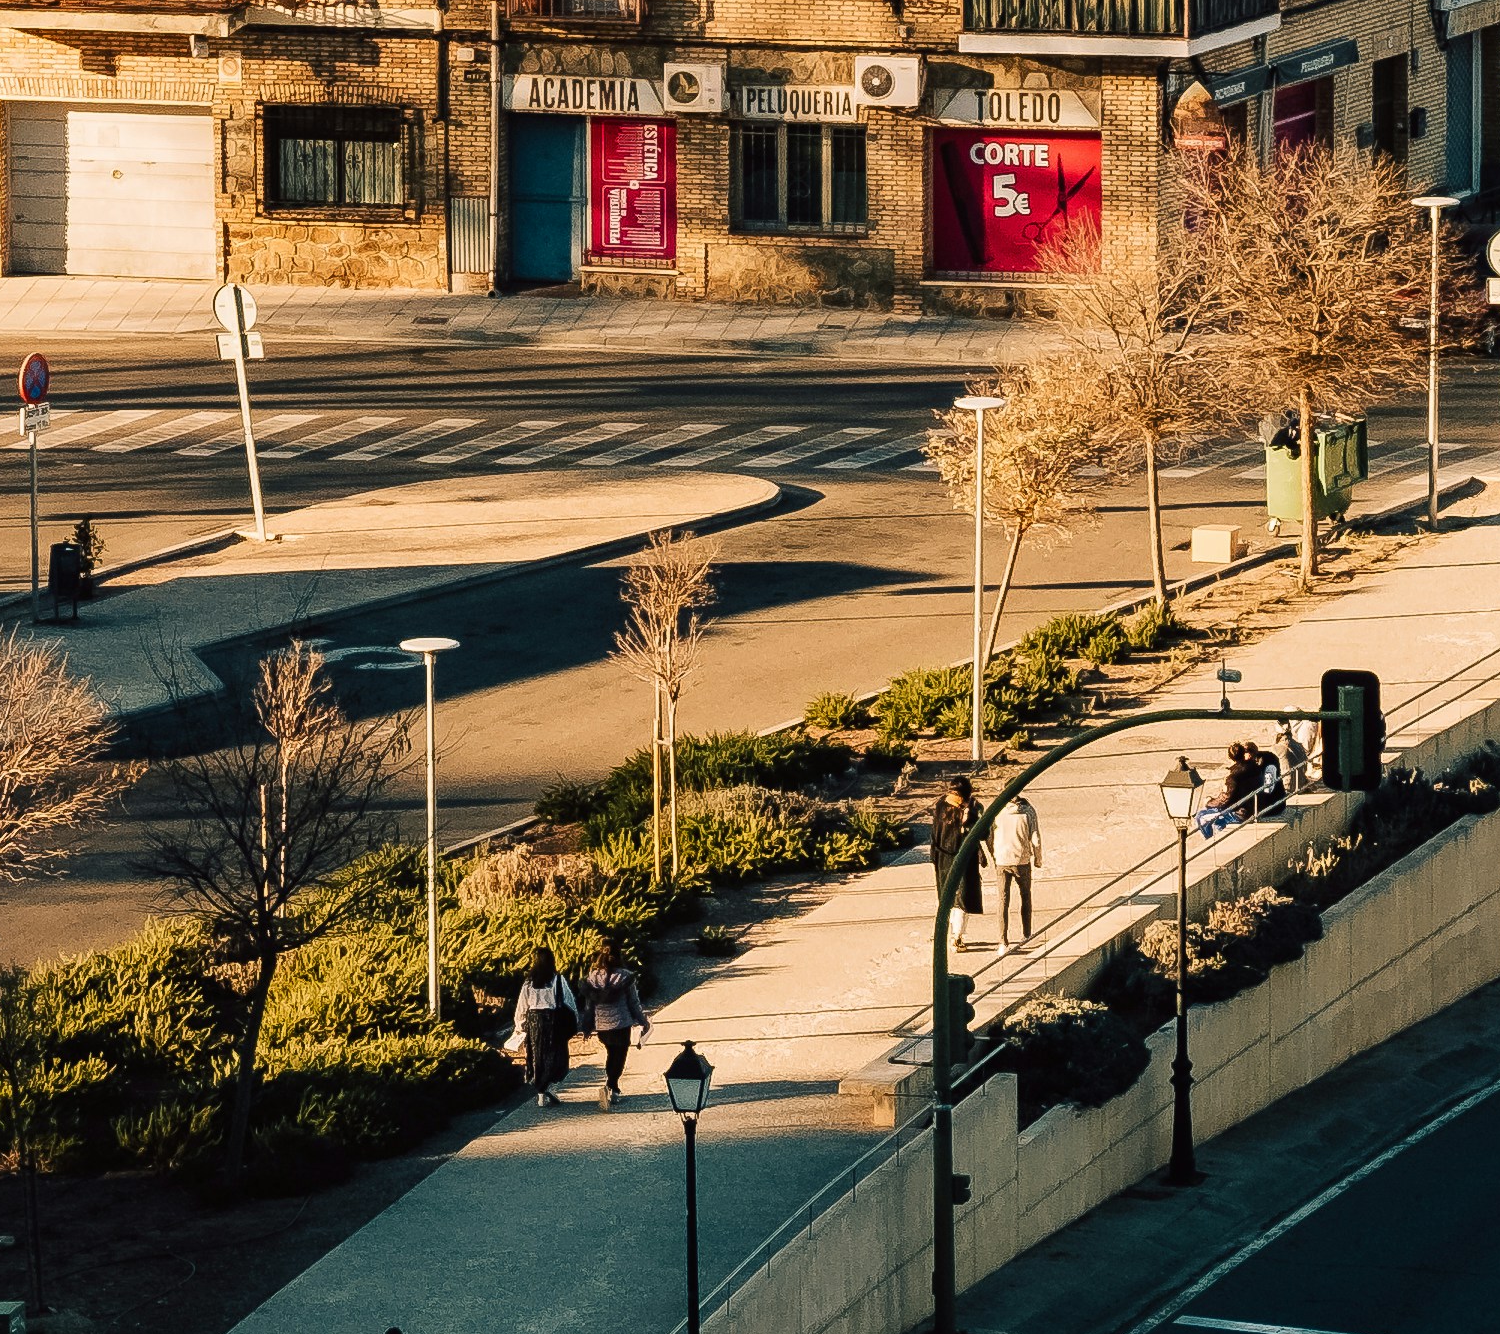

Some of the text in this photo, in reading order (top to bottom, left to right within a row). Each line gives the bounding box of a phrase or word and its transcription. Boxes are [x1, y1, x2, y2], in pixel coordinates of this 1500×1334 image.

[528, 77, 641, 112] ACADEMIA
[747, 87, 852, 119] PELUQUERIA
[974, 89, 1061, 123] TOLEDO
[969, 142, 1050, 168] CORTE
[992, 173, 1031, 218] 5€
